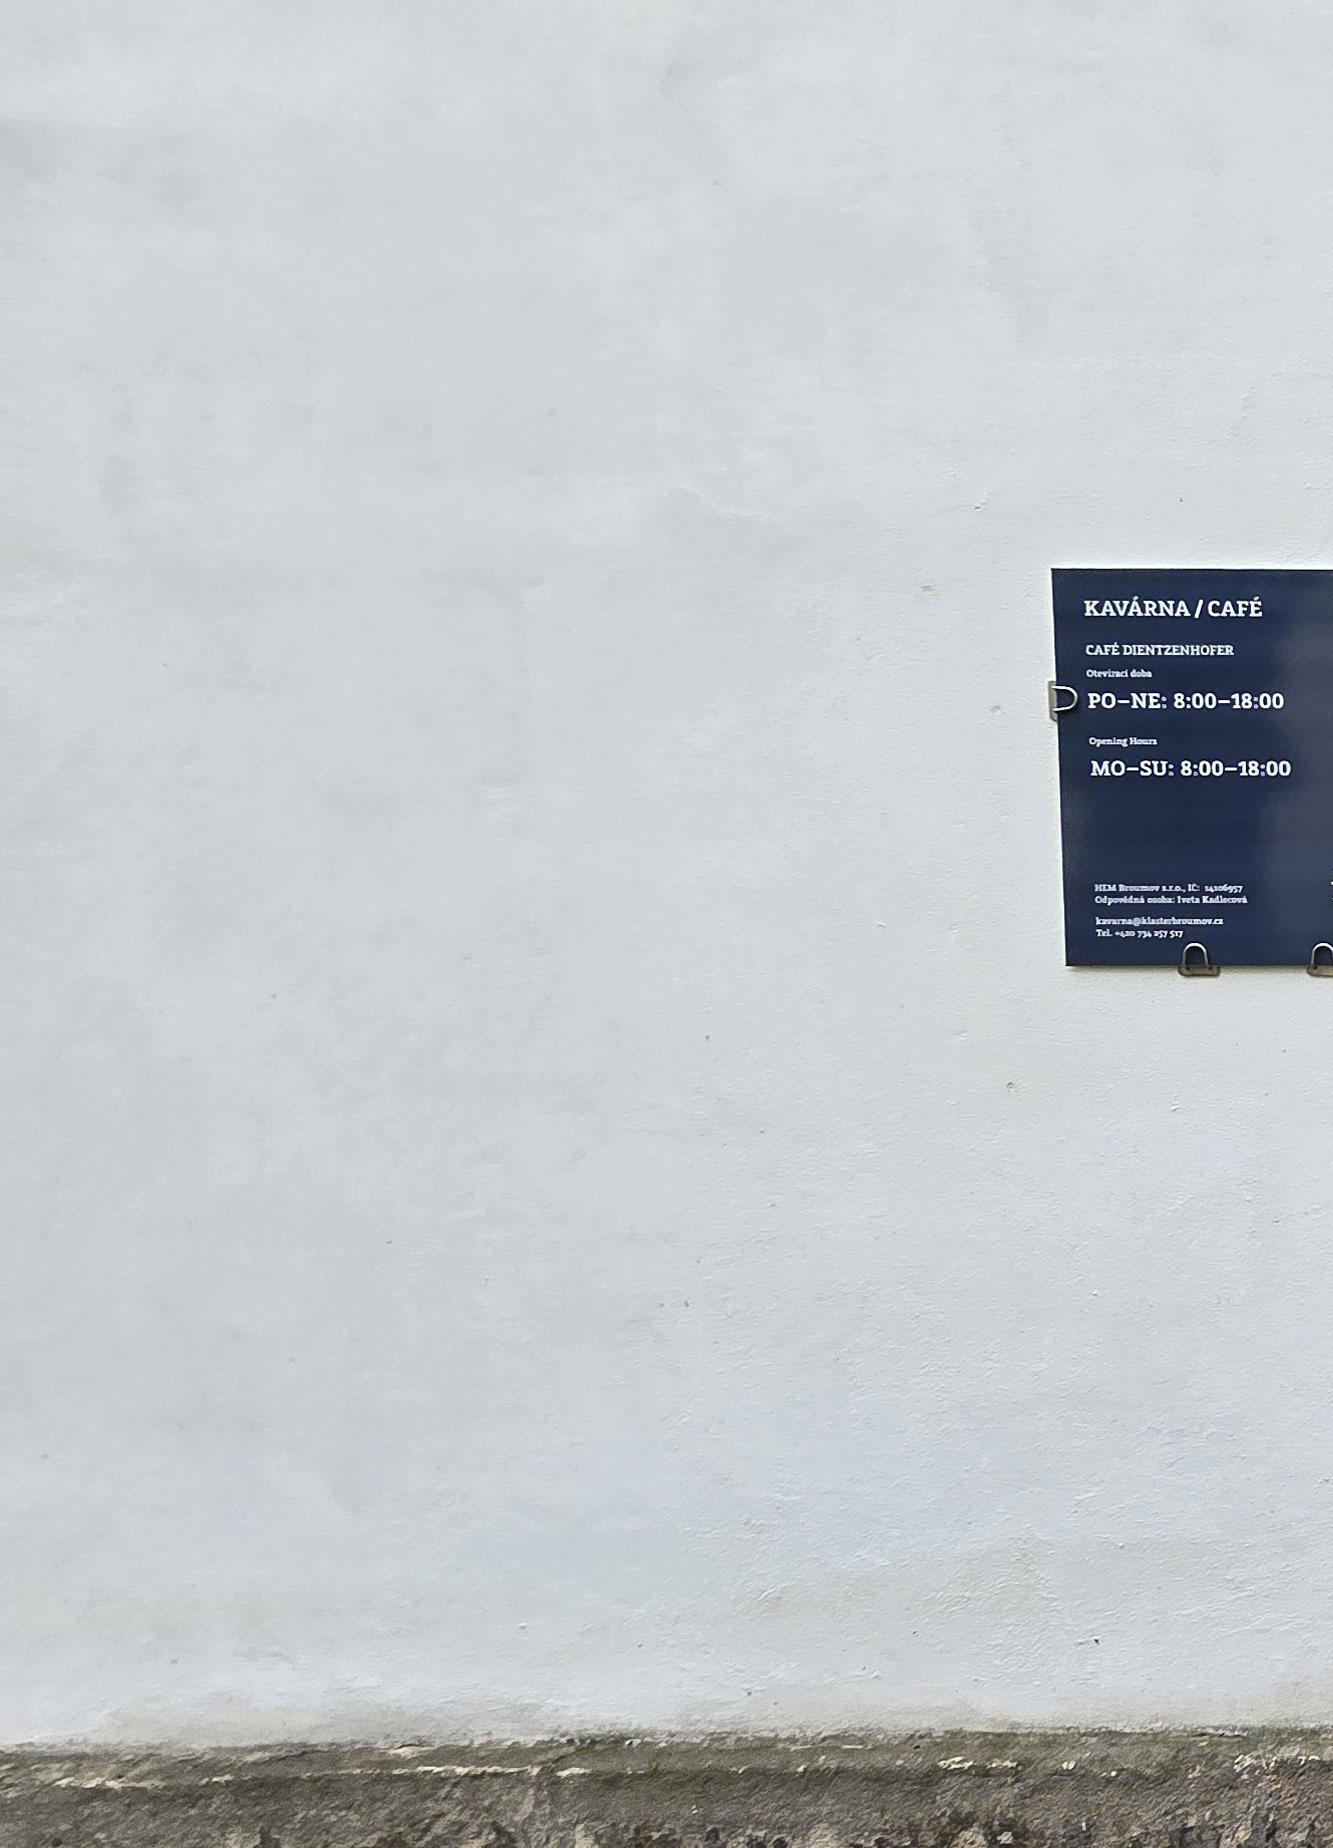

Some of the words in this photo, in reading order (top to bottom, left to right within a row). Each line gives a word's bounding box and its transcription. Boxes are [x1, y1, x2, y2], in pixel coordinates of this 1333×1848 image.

[1083, 595, 1192, 618] KAVÁRNA
[1193, 598, 1204, 619] /
[1207, 595, 1263, 618] CAFÉ
[1085, 641, 1121, 656] CAFÉ
[1122, 644, 1235, 656] DIENTZENHOFER
[1130, 668, 1153, 678] doba
[1088, 736, 1128, 748] Opening
[1129, 736, 1158, 746] Hours
[1118, 883, 1161, 892] Broumov
[1094, 895, 1146, 907] Odpovědná
[1146, 895, 1176, 904] osoba:
[1176, 895, 1201, 904] Iveta
[1201, 895, 1248, 904] Kadlecová
[1095, 916, 1225, 927] kavarna@klasterbroumov.cz
[1114, 930, 1136, 938] +420
